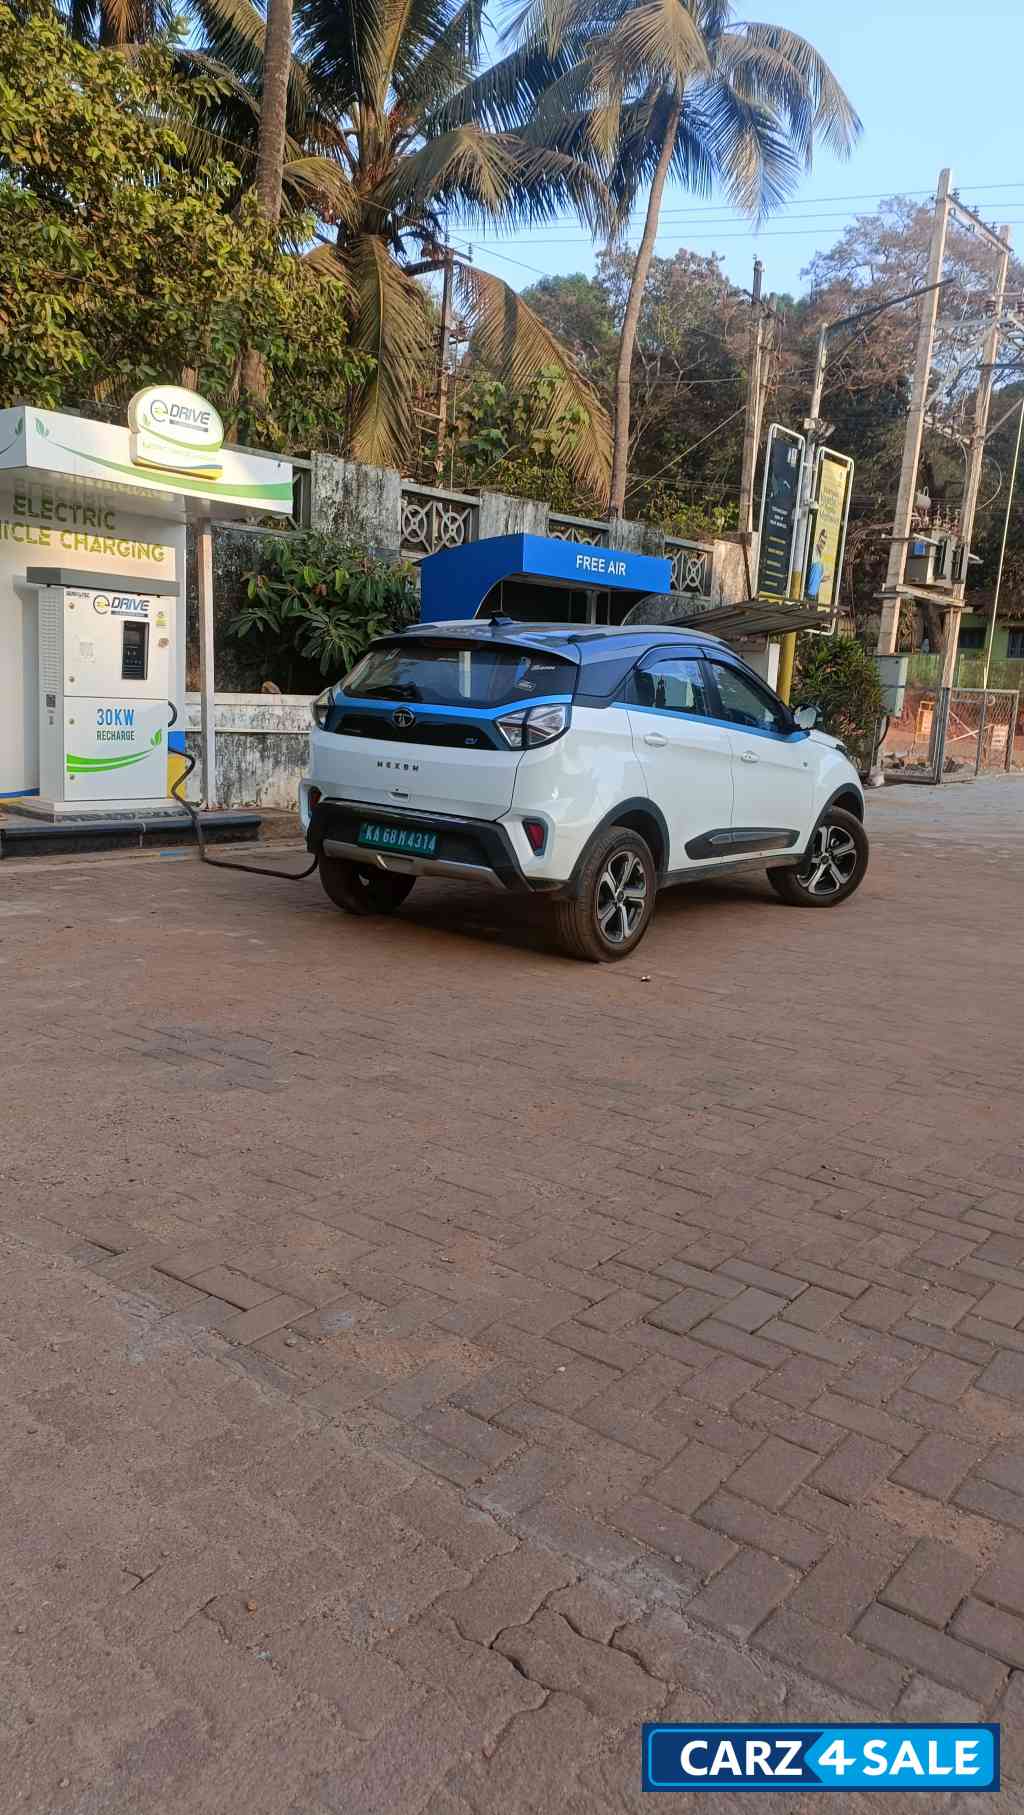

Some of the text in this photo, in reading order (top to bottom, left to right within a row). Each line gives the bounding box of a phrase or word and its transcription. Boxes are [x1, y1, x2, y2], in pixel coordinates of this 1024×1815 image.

[13, 495, 116, 530] ELECTRIC
[0, 519, 165, 562] ICLE CHARGING
[576, 554, 626, 576] FREE AIR
[96, 708, 135, 726] 30KW
[96, 730, 135, 741] RECHARGE
